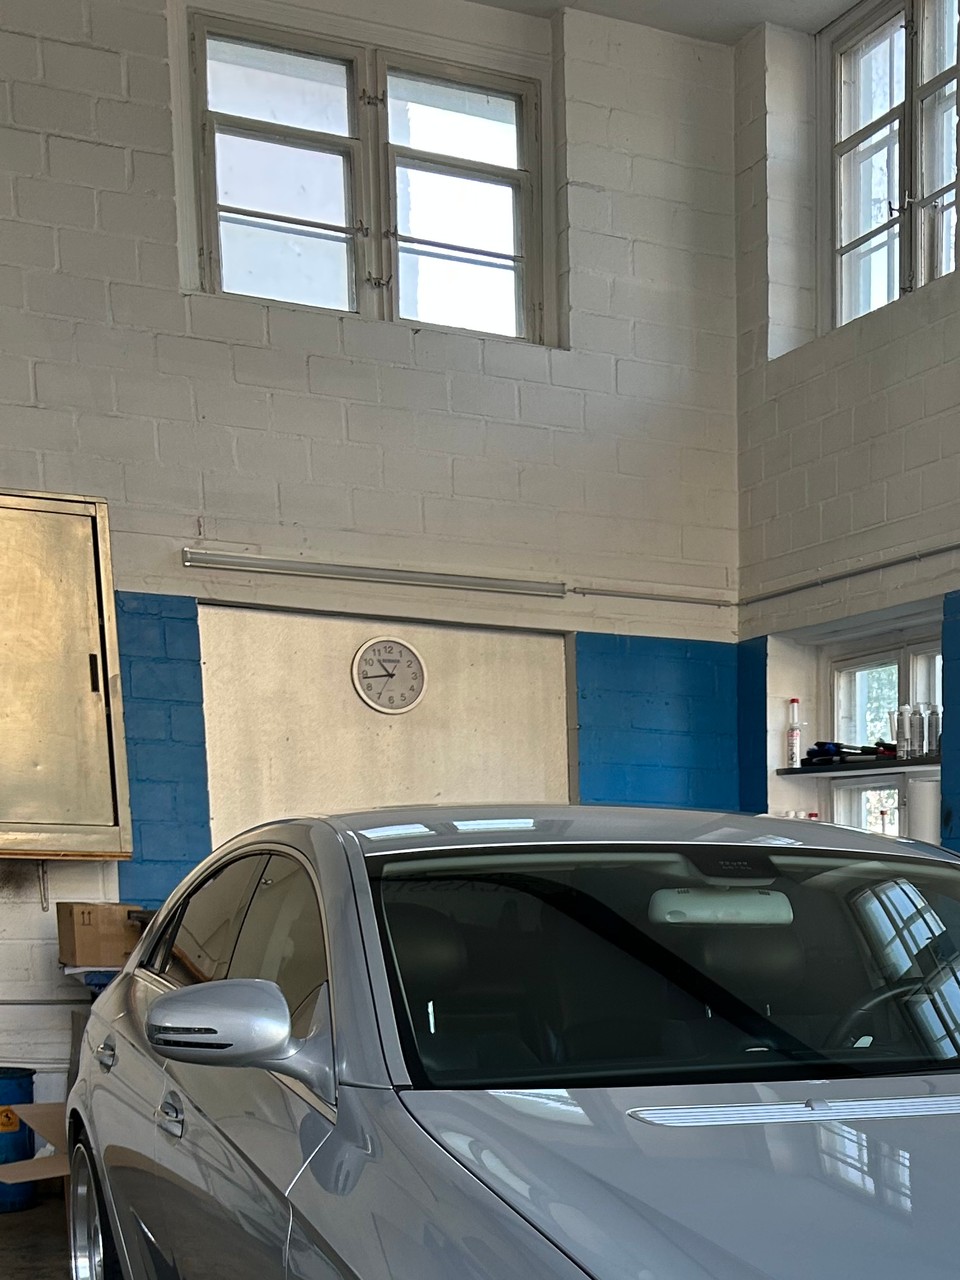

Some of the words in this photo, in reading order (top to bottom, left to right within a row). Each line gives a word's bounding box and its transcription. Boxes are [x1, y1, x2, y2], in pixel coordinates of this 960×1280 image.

[384, 646, 393, 654] 12
[398, 650, 403, 658] 1
[364, 658, 374, 666] 10
[406, 660, 413, 668] 2
[362, 670, 368, 678] 9
[411, 672, 418, 680] 3
[366, 683, 373, 691] 8
[375, 691, 382, 700] 7
[400, 693, 406, 701] 5
[388, 696, 395, 704] 6
